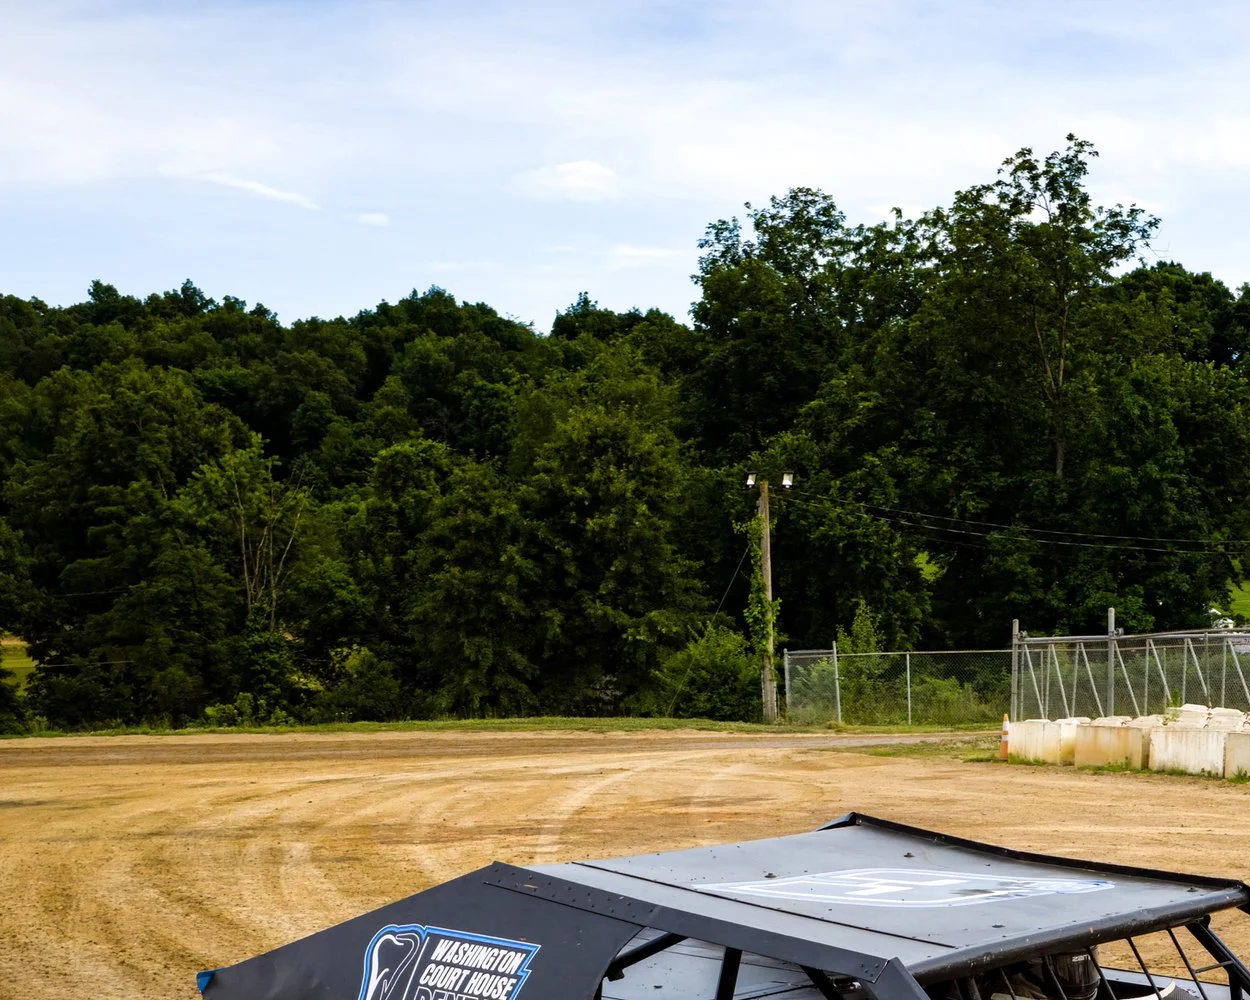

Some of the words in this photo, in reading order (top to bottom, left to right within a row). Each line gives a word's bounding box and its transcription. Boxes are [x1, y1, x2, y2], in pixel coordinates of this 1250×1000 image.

[431, 938, 526, 975] WASHINGTON
[419, 963, 470, 993] COURT
[463, 971, 518, 1000] HOUSE
